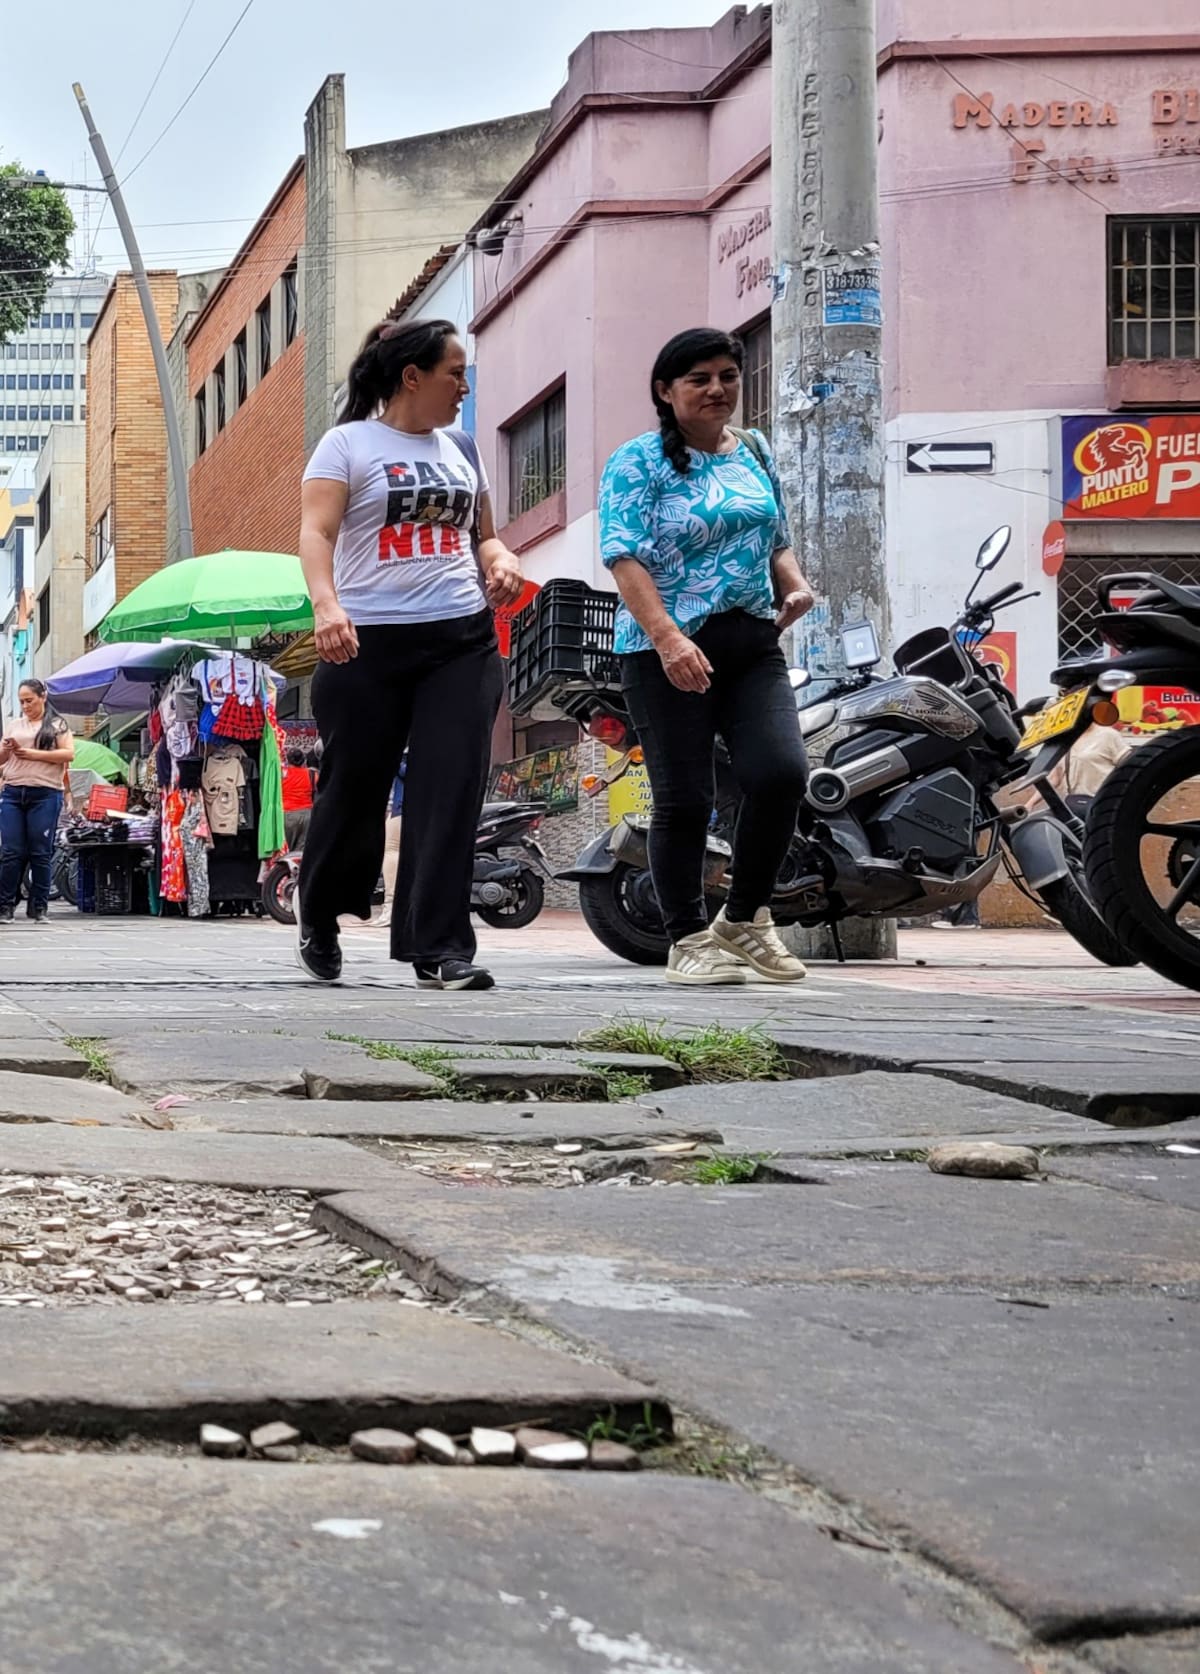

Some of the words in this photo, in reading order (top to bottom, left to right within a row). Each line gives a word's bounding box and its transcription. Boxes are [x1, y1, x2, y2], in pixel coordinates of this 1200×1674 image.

[953, 91, 1119, 130] MADERA
[1156, 432, 1200, 459] FUE
[1081, 479, 1149, 510] MALTERO
[1082, 460, 1149, 496] PUNTO
[378, 522, 464, 562] NIA
